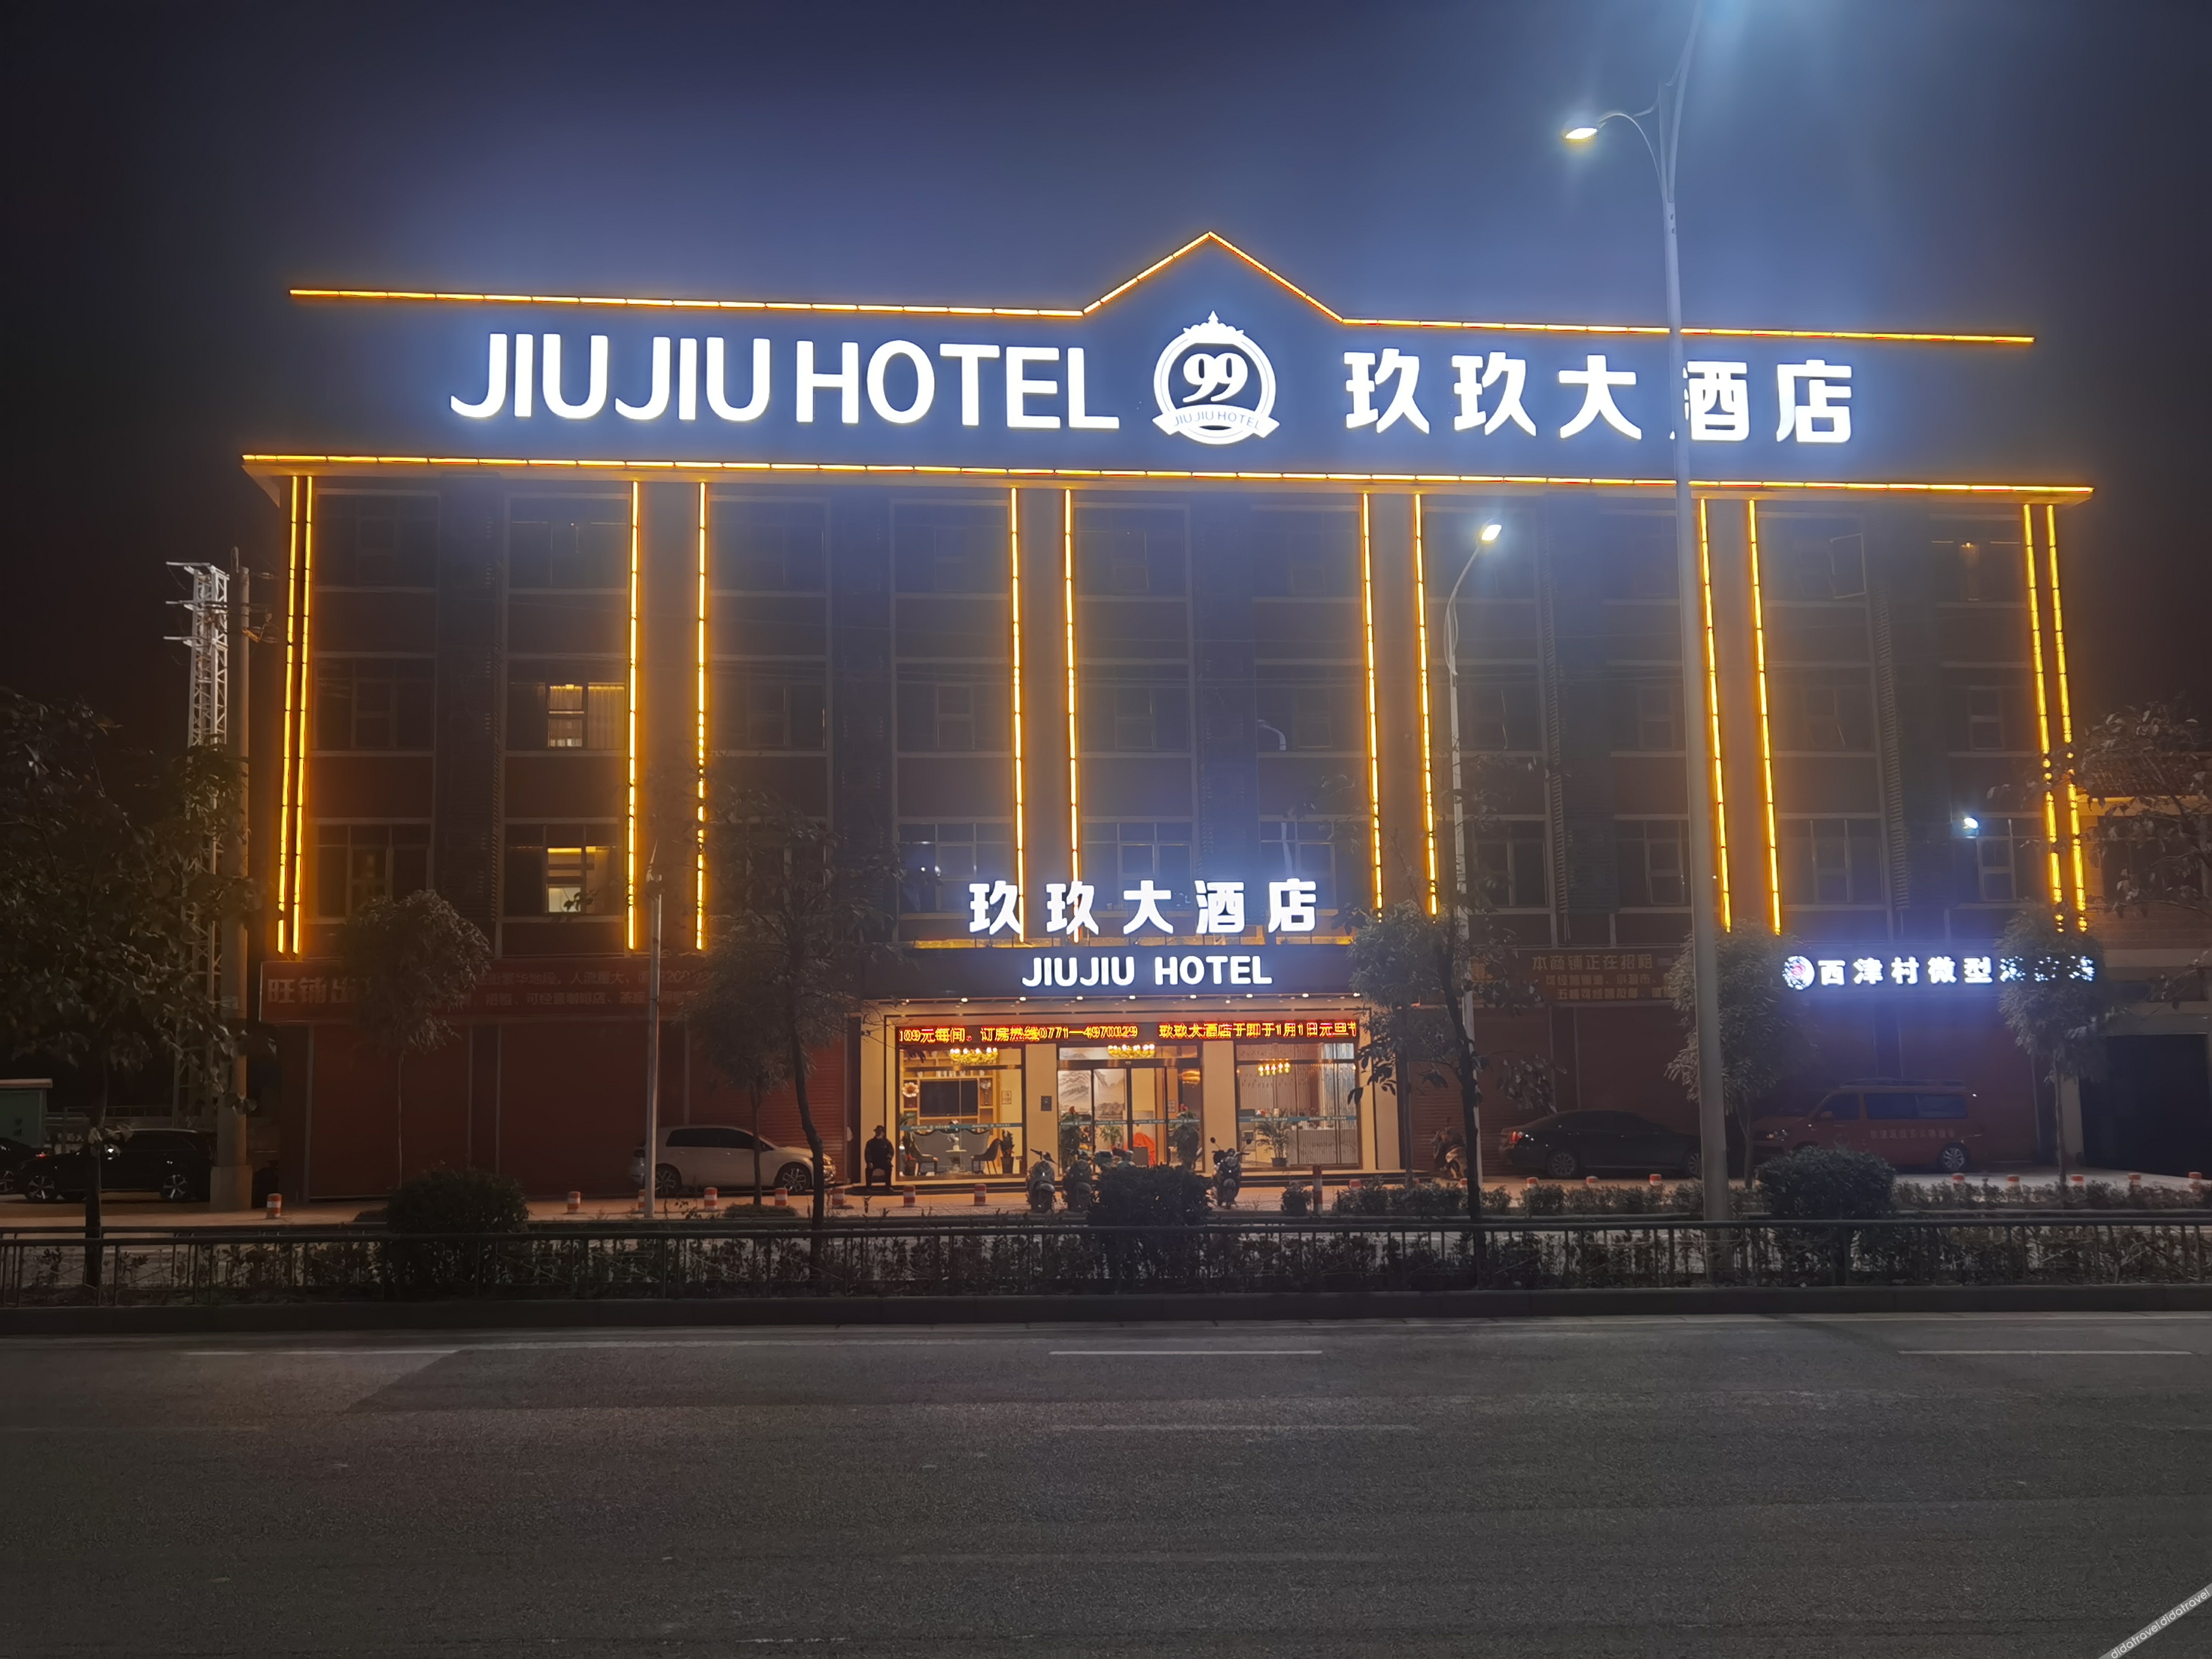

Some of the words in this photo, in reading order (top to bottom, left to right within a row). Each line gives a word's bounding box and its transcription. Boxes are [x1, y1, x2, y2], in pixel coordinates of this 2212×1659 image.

[450, 333, 771, 422] JIUJIU
[795, 339, 1120, 429] HOTEL
[1183, 352, 1248, 403] 99
[1343, 348, 1852, 443] 玖玖大酒店
[1218, 412, 1260, 430] HOTEL
[968, 878, 1317, 935] 玖玖大酒店
[1022, 956, 1135, 987] JIUJIU
[1154, 955, 1272, 986] HOTEL
[1532, 954, 1653, 970] 本商铺正在招租
[1818, 956, 2095, 986] 西津村微型
